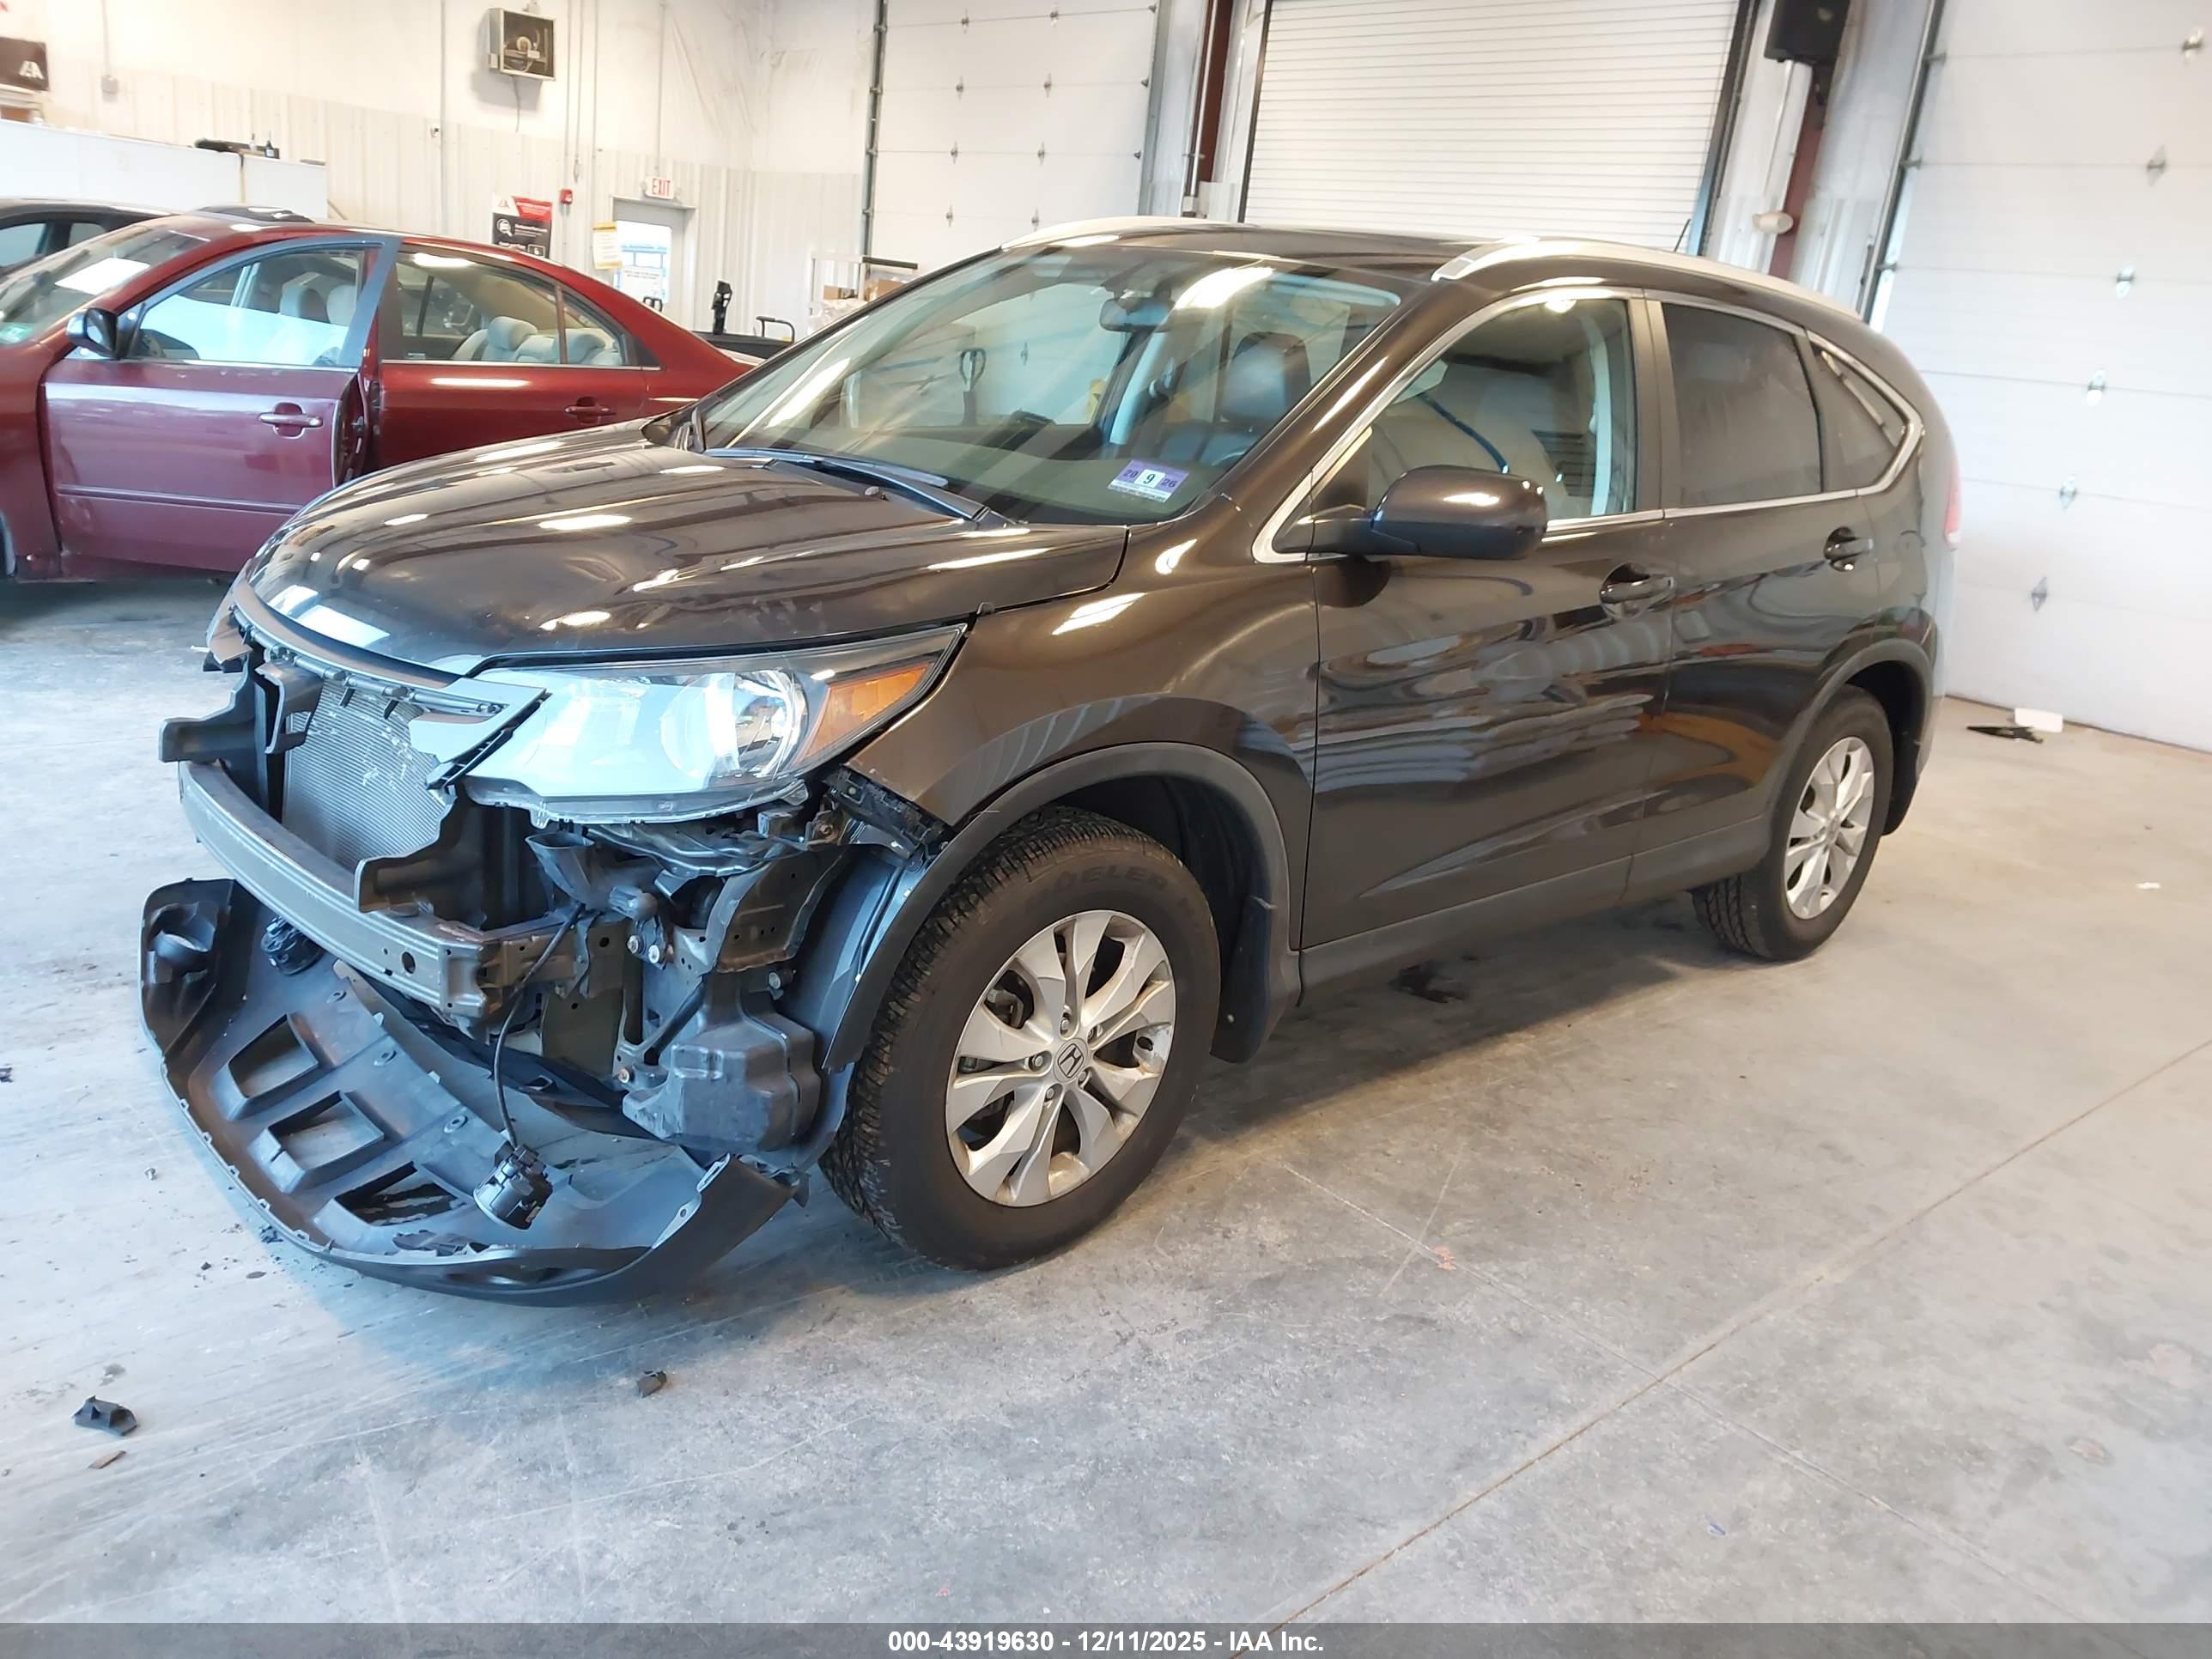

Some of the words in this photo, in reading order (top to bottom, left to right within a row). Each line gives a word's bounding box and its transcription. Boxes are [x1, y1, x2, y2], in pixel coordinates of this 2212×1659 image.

[652, 178, 672, 196] EXIT
[1123, 469, 1139, 478] 20
[1143, 473, 1156, 484] 9
[1161, 478, 1178, 488] 26
